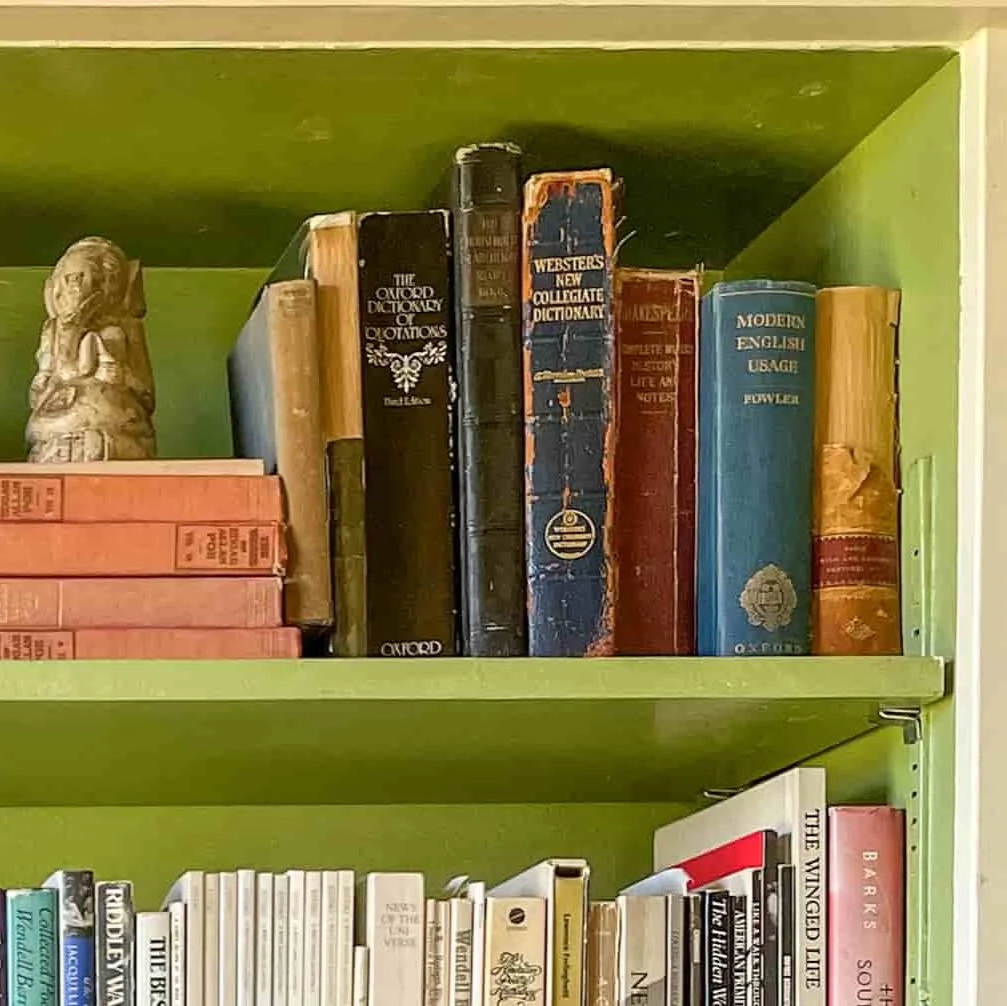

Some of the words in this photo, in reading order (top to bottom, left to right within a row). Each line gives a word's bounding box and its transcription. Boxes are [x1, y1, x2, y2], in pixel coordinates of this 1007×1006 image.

[533, 255, 606, 273] WEBSTER'S
[393, 274, 416, 287] THE
[555, 273, 583, 288] NEW
[375, 286, 435, 300] OXFORD
[533, 287, 604, 306] COLLEGIATE
[367, 299, 443, 314] DICTIONARY
[533, 304, 606, 322] DICTIONARY
[395, 313, 416, 326] OF
[736, 313, 806, 329] MODERN
[365, 325, 448, 343] QUOTATIONS
[736, 336, 806, 352] ENGLISH
[748, 358, 799, 374] USAGE
[743, 392, 800, 405] FOWLER
[381, 640, 442, 657] OXFORD
[804, 808, 820, 851] THE
[805, 857, 821, 941] WINGED
[862, 850, 878, 930] BARKS
[711, 900, 728, 926] The
[15, 908, 34, 970] Wendell
[105, 887, 125, 974] RIDDLEY
[38, 907, 55, 976] Collected
[150, 936, 167, 973] THE
[455, 929, 472, 994] Wendell
[711, 930, 728, 984] Hidden
[806, 949, 822, 990] LIFE
